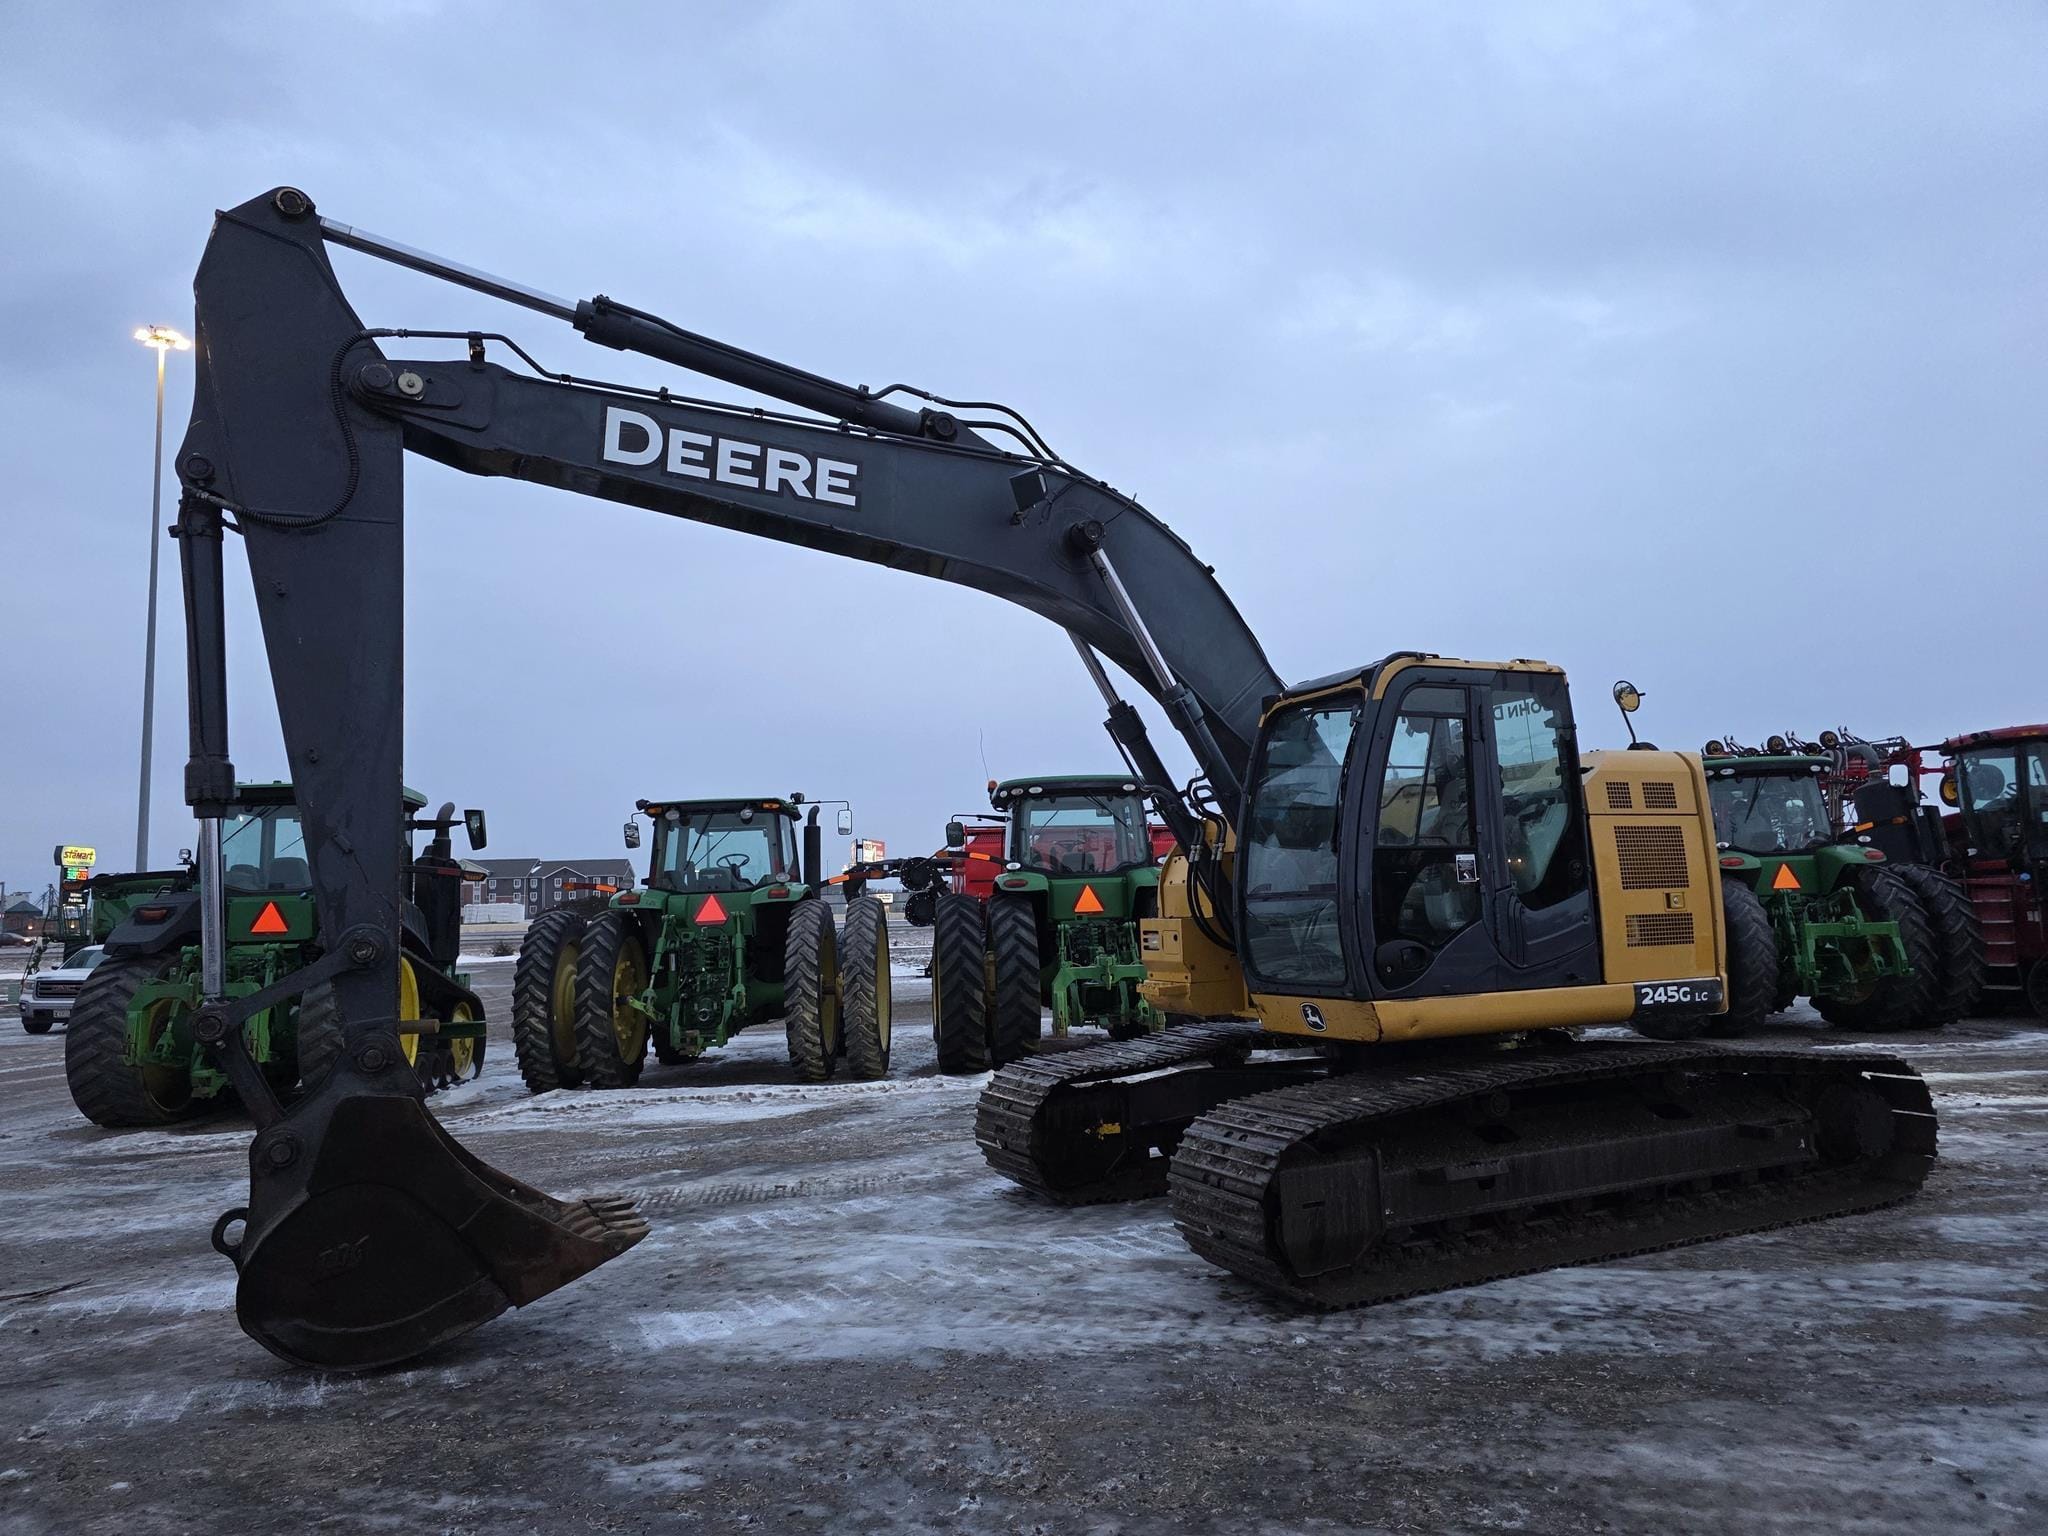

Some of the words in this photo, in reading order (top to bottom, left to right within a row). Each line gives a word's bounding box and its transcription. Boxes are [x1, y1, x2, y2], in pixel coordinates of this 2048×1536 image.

[603, 406, 858, 507] DEERE
[1641, 986, 1690, 1005] 245G
[1695, 991, 1708, 1002] LC
